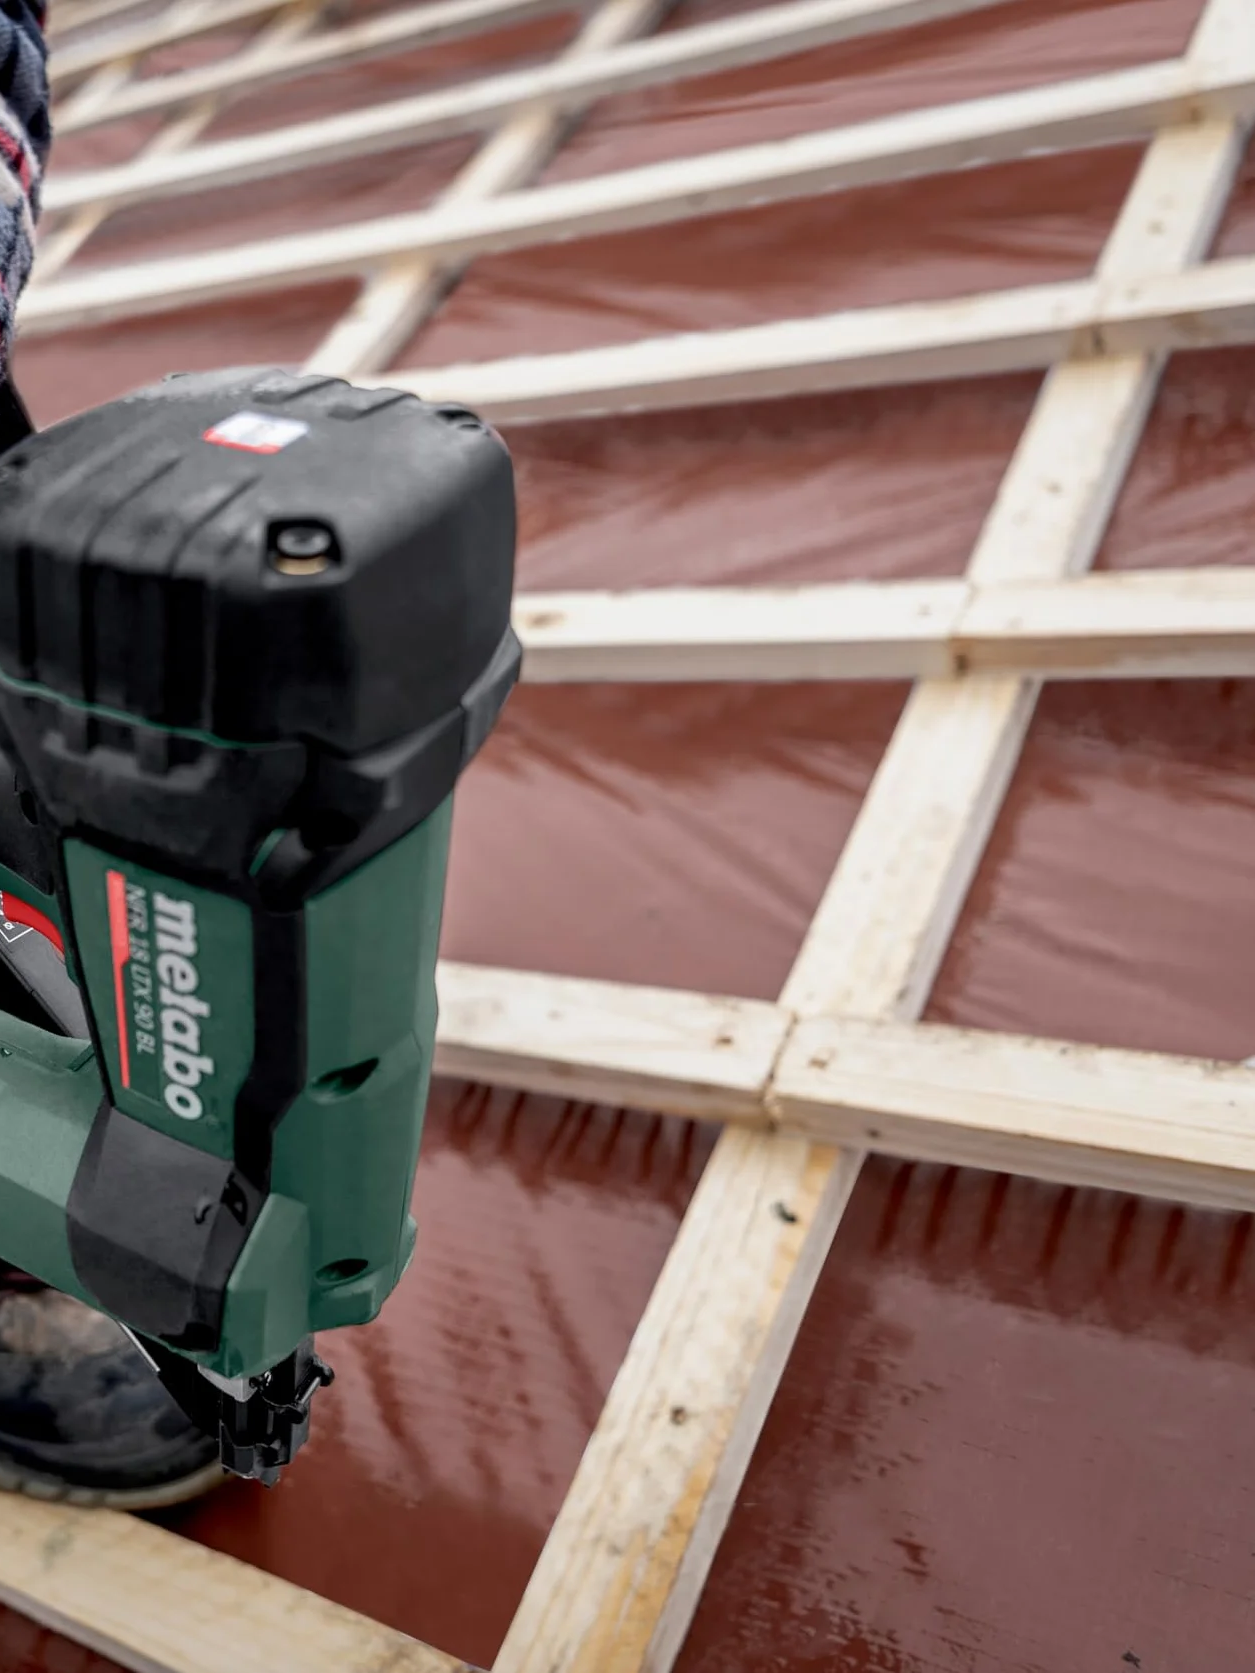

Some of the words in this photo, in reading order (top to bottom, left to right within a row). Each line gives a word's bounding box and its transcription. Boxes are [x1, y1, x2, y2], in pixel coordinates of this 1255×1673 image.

[126, 884, 148, 932] NFR
[129, 933, 151, 964] 18
[130, 964, 153, 1002] LTX
[133, 1003, 154, 1031] 90
[153, 892, 214, 1120] metabo
[136, 1032, 155, 1055] BL
